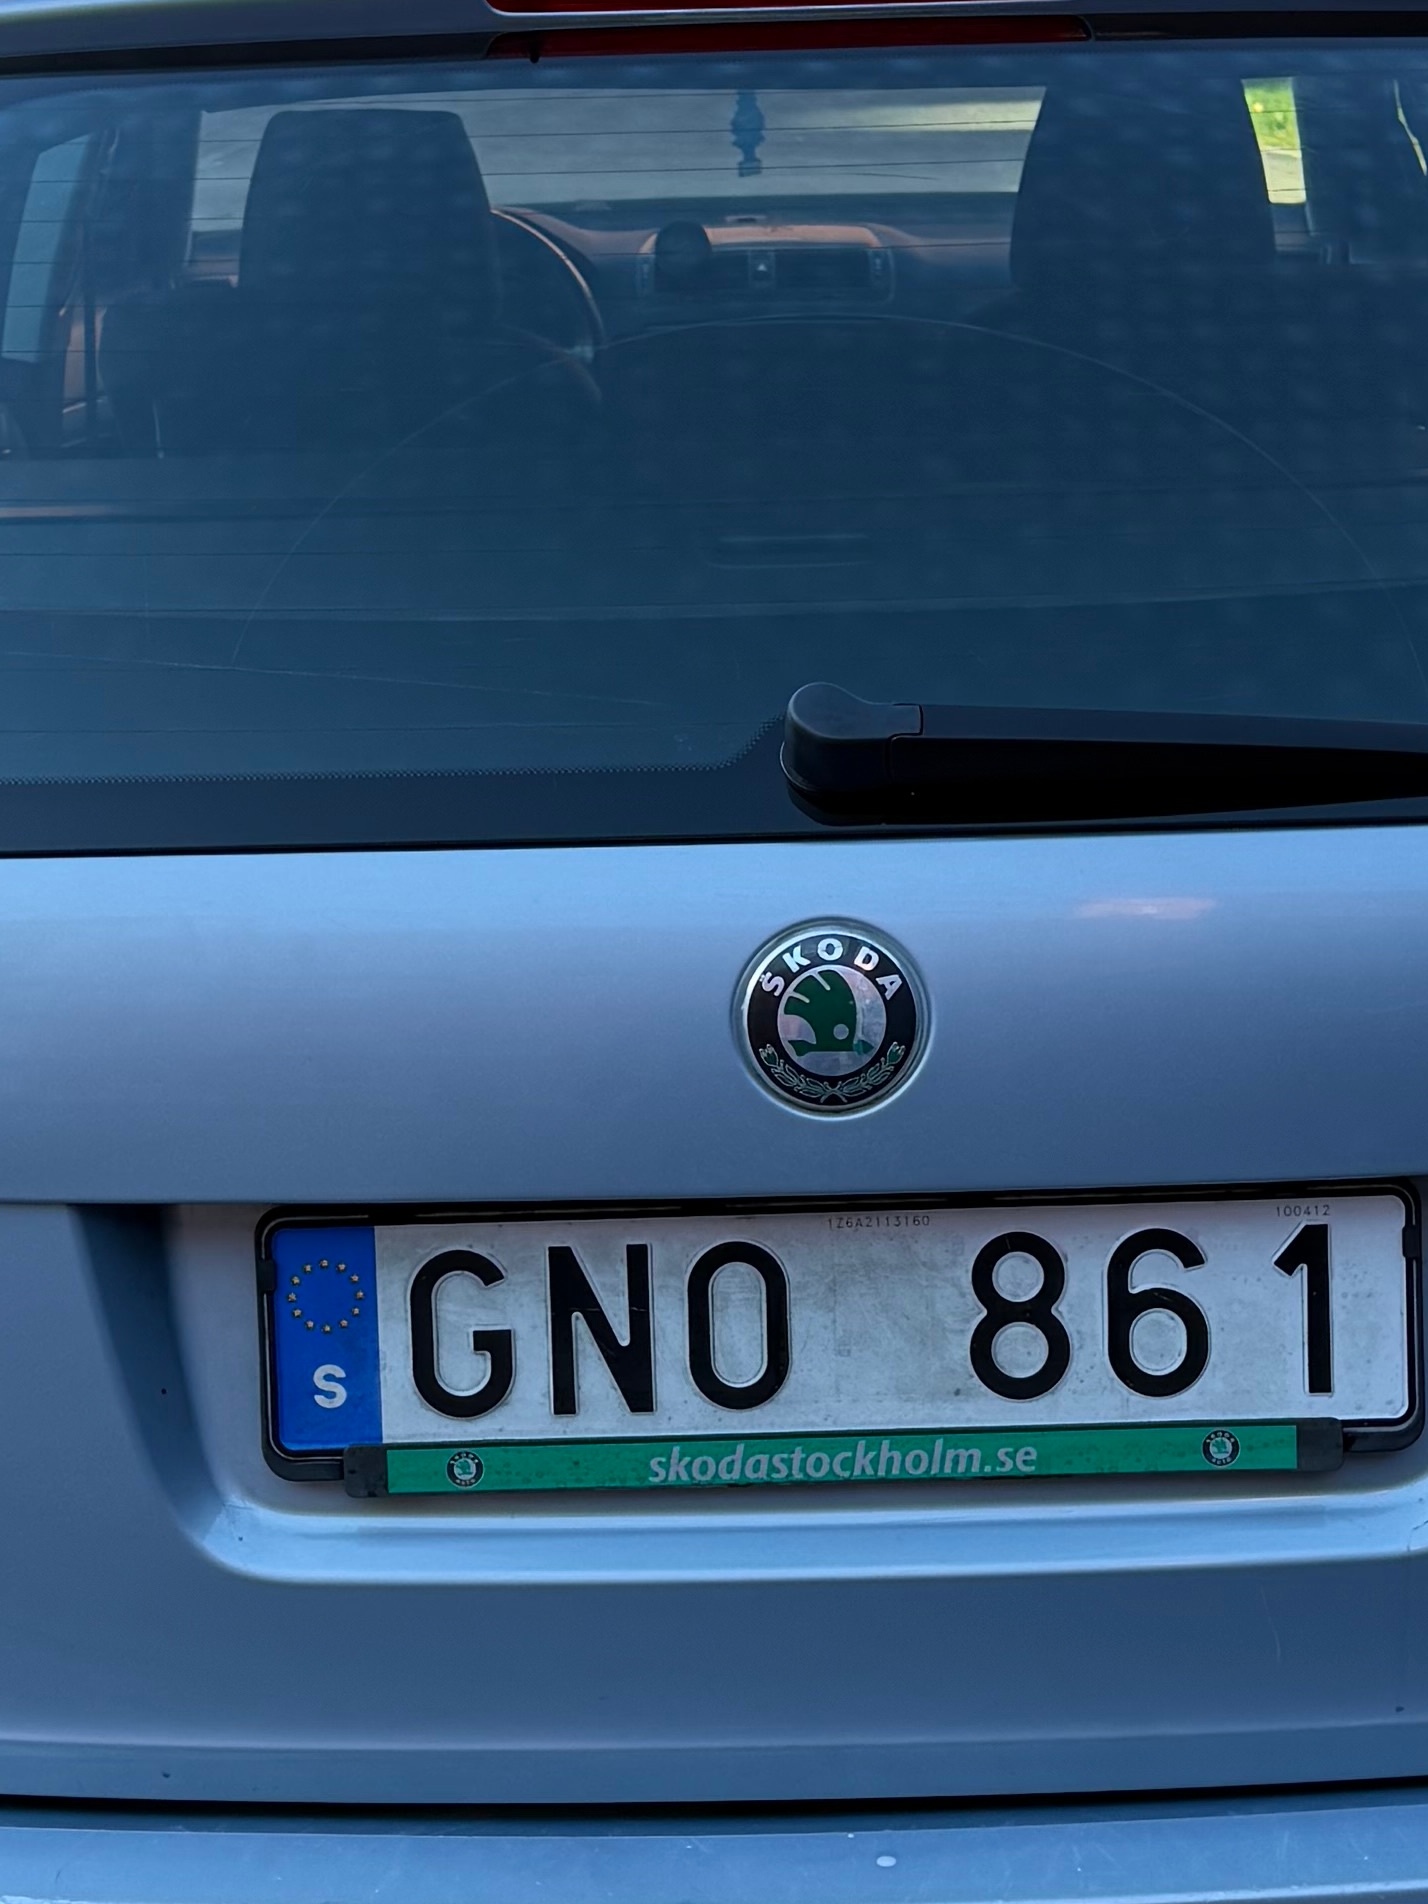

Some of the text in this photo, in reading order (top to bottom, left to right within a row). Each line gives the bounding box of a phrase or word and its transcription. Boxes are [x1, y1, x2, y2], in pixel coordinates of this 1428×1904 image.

[1276, 1204, 1331, 1217] 100412
[409, 1222, 1334, 1419] GNO 861
[312, 1363, 348, 1409] S
[648, 1438, 1038, 1483] skodastockholm.se
